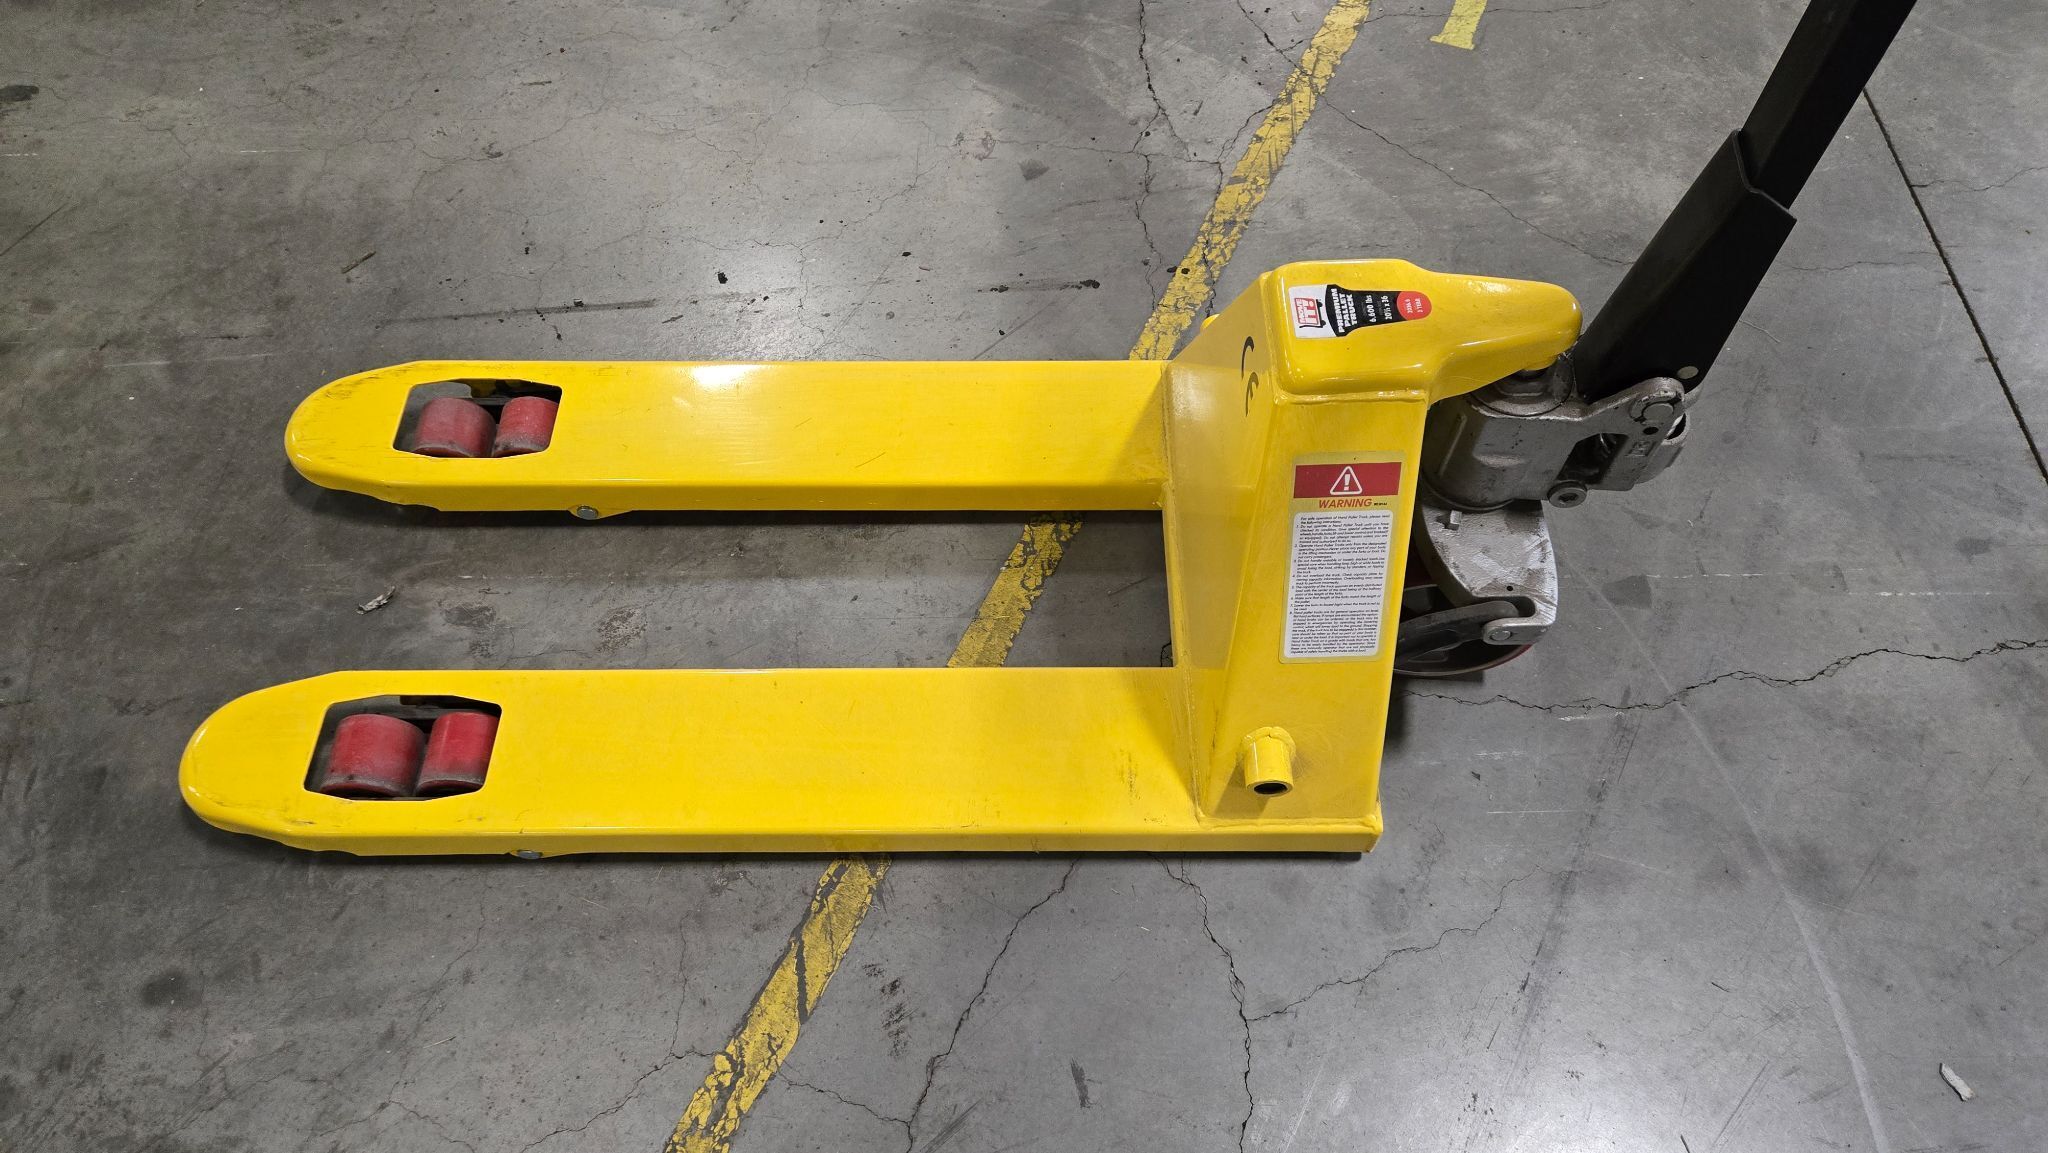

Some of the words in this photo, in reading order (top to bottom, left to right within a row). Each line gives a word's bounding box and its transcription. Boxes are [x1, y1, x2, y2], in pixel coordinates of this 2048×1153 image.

[1296, 299, 1304, 323] MOVE
[1302, 300, 1318, 323] IT!
[1331, 288, 1344, 332] PREMIUM
[1340, 293, 1351, 327] PALLET
[1346, 294, 1358, 325] TRUCK
[1319, 498, 1372, 508] WARNING
